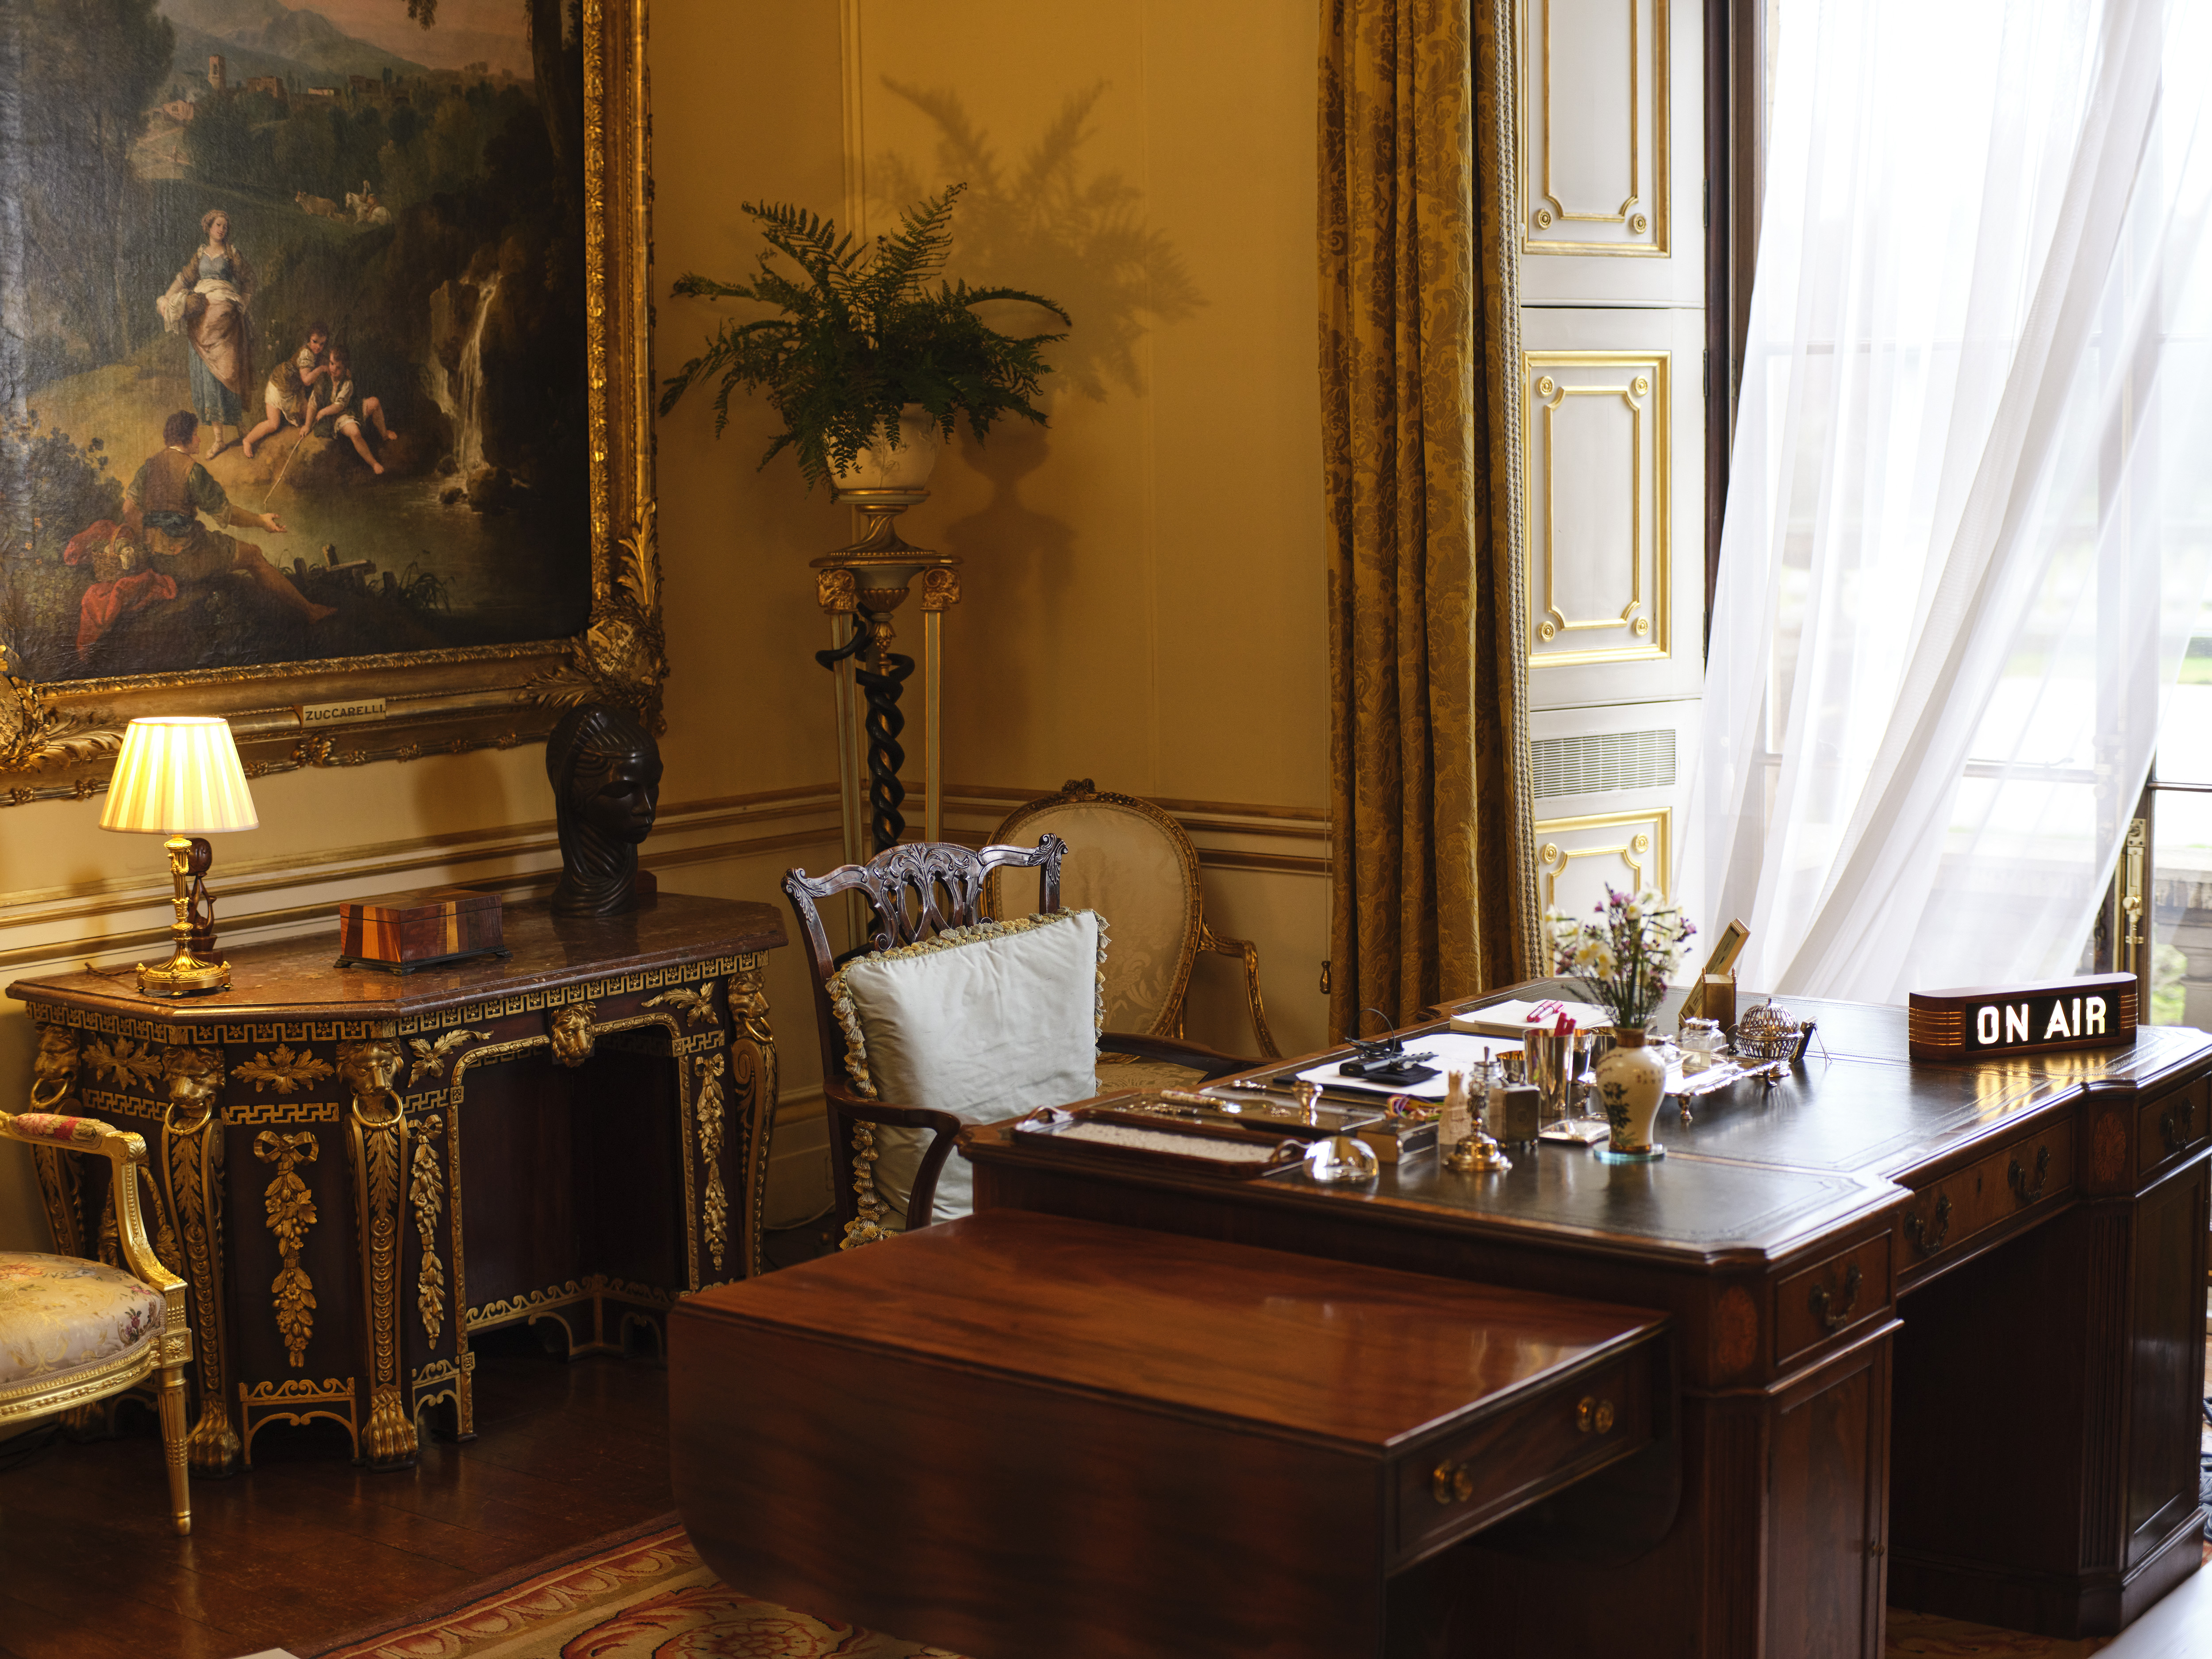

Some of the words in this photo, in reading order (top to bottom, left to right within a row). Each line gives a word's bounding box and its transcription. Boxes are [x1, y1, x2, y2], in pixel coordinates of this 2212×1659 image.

[305, 704, 386, 721] ZUCCARELLI.
[1978, 1003, 2028, 1044] ON
[2043, 996, 2107, 1039] AIR
